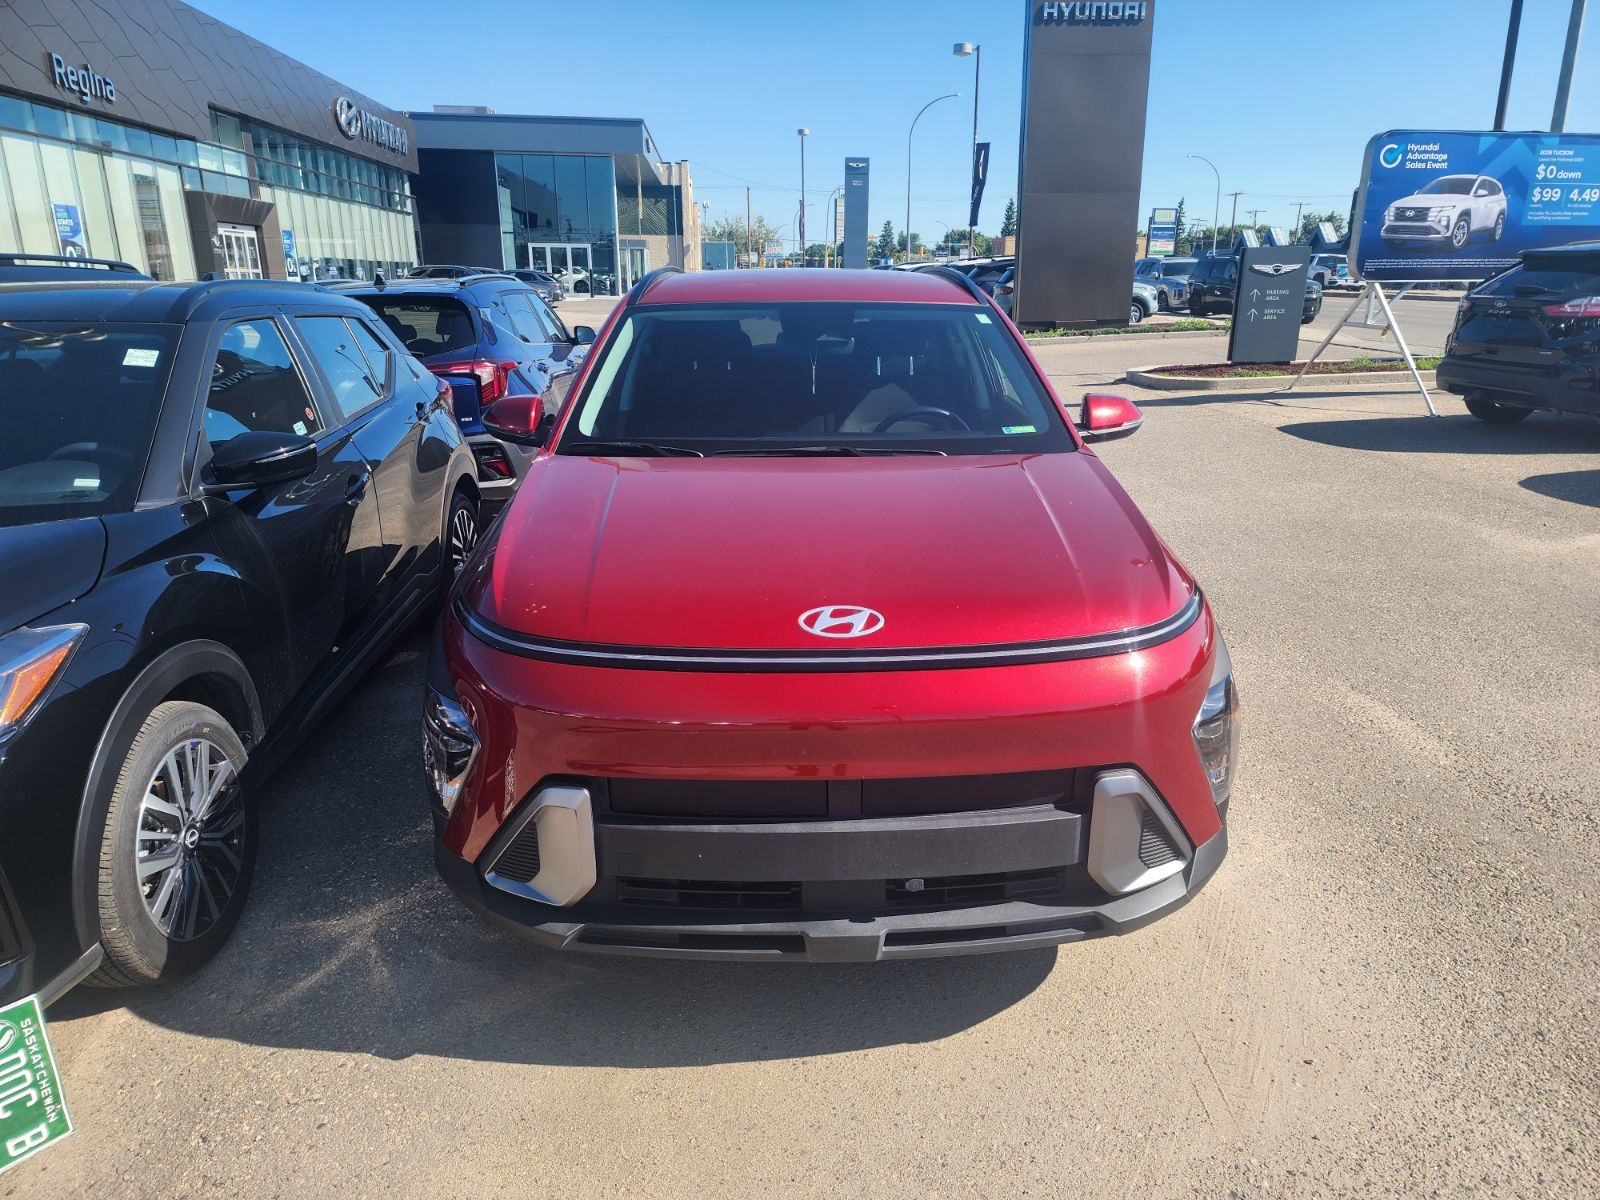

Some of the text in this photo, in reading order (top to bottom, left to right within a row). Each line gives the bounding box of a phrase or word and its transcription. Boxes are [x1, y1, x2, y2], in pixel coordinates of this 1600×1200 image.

[1043, 1, 1146, 20] HYUNDAI
[51, 52, 116, 102] Regina
[1406, 152, 1448, 161] Advantage
[1407, 143, 1440, 153] Hyundai
[1405, 161, 1448, 169] Sales Event
[1535, 163, 1582, 180] $0 down
[1531, 186, 1561, 203] $99
[1569, 188, 1600, 202] 4.49
[19, 1017, 57, 1123] SASKATCHEWAN
[6, 1122, 49, 1157] B
